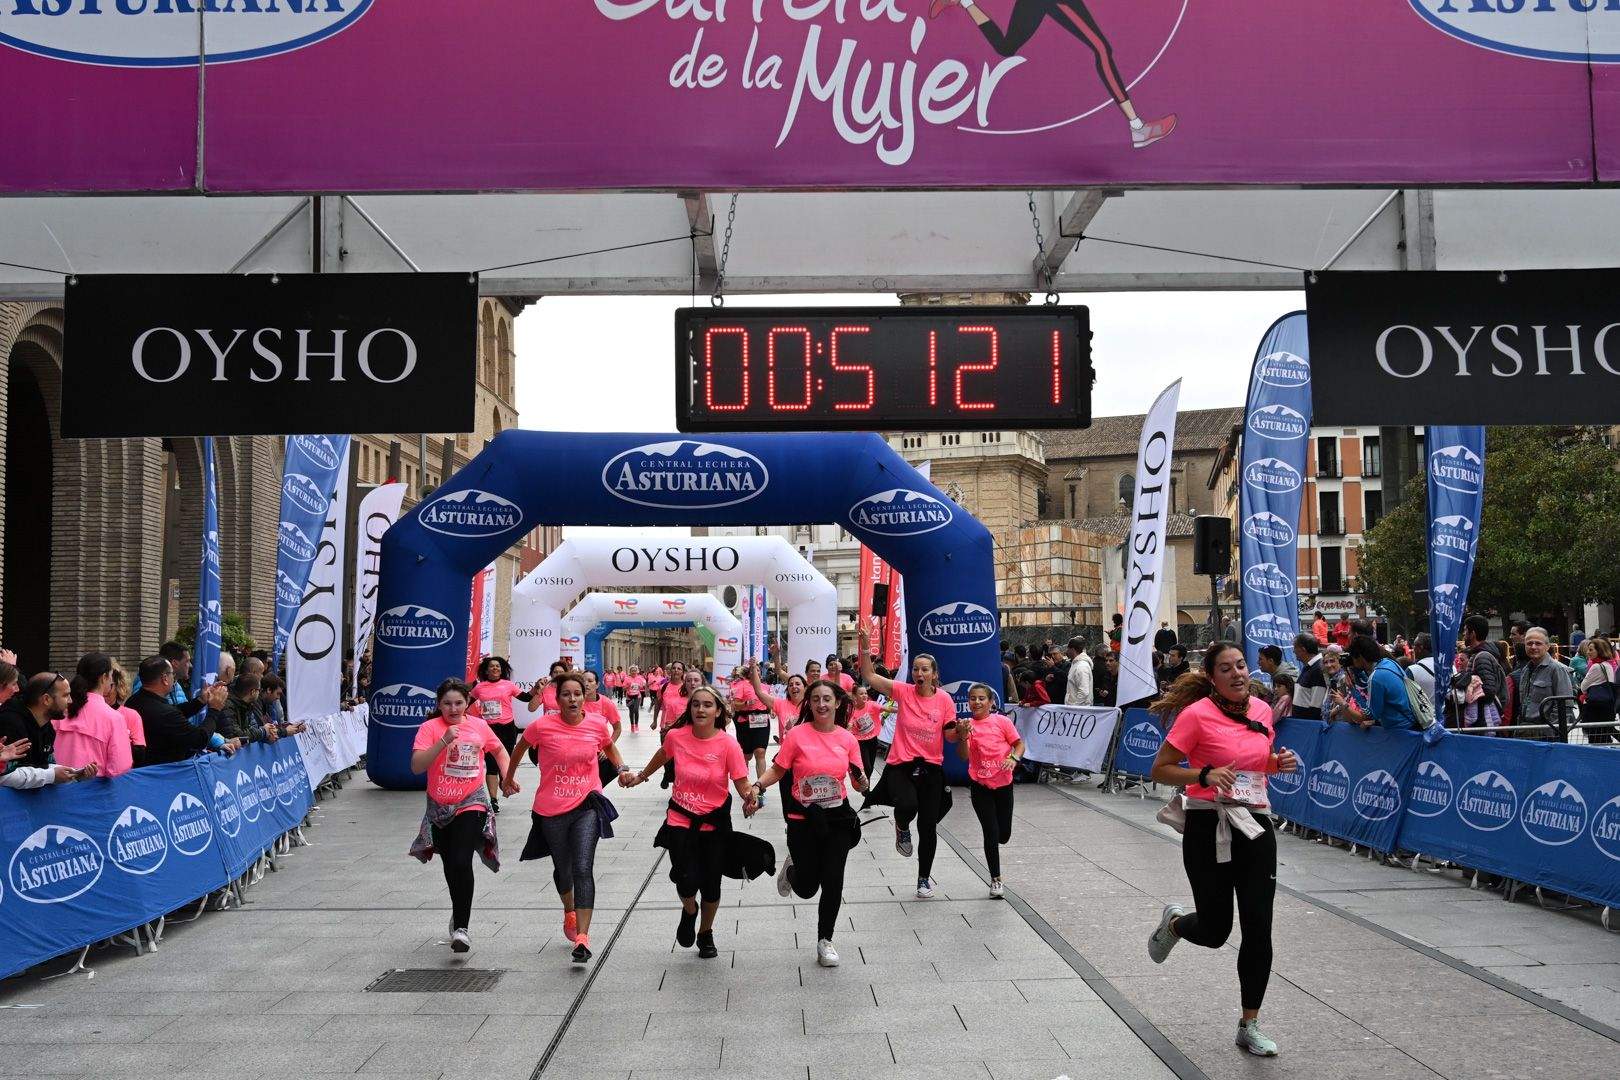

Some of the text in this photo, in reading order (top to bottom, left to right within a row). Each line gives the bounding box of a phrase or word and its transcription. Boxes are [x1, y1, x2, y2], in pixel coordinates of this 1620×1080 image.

[669, 16, 1028, 166] de la Mujer
[131, 327, 418, 383] OYSHO
[1261, 364, 1308, 380] ASTURIANA
[1252, 414, 1304, 434] ASTURIANA
[641, 460, 751, 468] CENTRAL LECHERA
[615, 461, 757, 491] ASTURIANA
[1248, 468, 1296, 487] ASTURIANA
[285, 479, 324, 513] ASTURIANA
[424, 506, 514, 526] ASTURIANA
[859, 508, 947, 525] ASTURIANA
[1128, 431, 1166, 645] OYSHO
[611, 546, 740, 573] OYSHO
[534, 576, 574, 586] OYSHO
[775, 573, 814, 582] OYSHO
[378, 621, 448, 639] ASTURIANA
[515, 628, 552, 638] OYSHO
[795, 626, 831, 635] OYSHO
[923, 619, 993, 637] ASTURIANA
[1037, 711, 1096, 739] OYSHO
[554, 764, 567, 773] TU
[555, 774, 591, 786] DORSAL
[437, 787, 463, 796] SUMA
[553, 787, 583, 798] SUMA
[1235, 788, 1251, 797] 016
[1412, 786, 1448, 806] TURIANA
[1460, 788, 1511, 819] ASTURIANA
[1524, 800, 1580, 832] ASTURIANA
[171, 817, 211, 844] ASTURIANA
[116, 833, 165, 863] ASTURIANA
[20, 852, 99, 892] ASTURIANA
